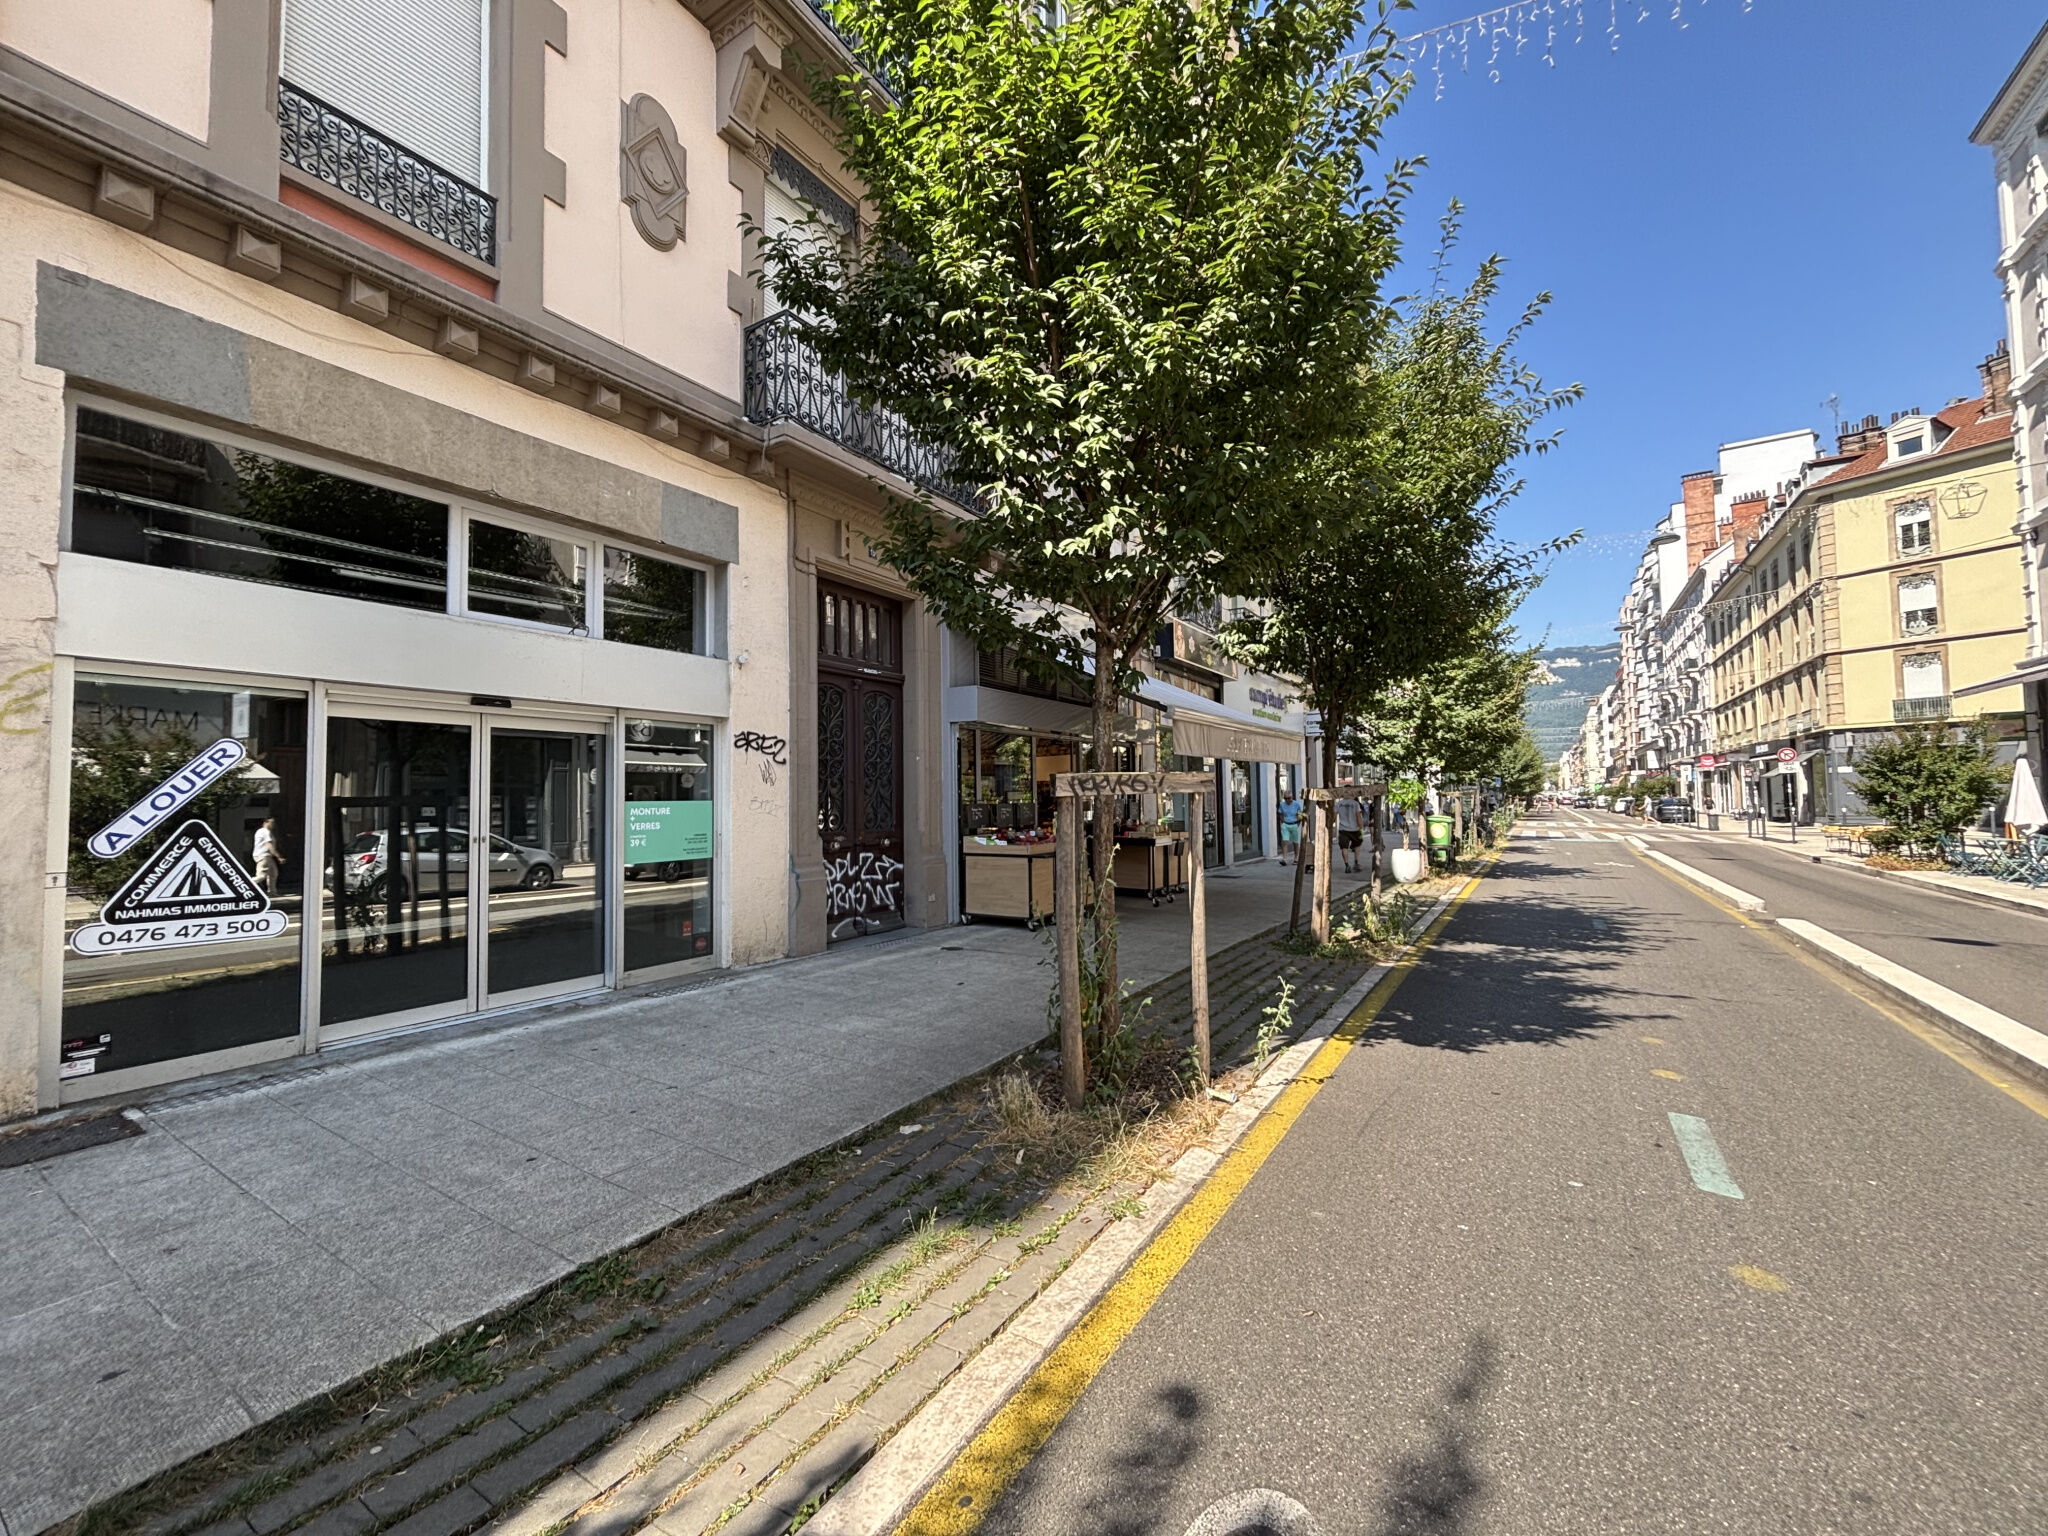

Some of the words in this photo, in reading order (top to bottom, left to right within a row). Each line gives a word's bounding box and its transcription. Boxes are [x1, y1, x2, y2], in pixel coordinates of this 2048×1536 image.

[104, 832, 133, 852] A
[129, 747, 236, 827] LOUER
[630, 807, 671, 816] MONTURE
[630, 822, 661, 831] VERRES
[630, 839, 641, 847] 39
[124, 836, 193, 908] COMMERCE
[198, 836, 255, 900] ENTREPRISE
[115, 906, 181, 920] NAHMIAS
[184, 900, 260, 914] IMMOBILIER
[98, 927, 165, 946] 0476
[174, 923, 219, 938] 473
[227, 919, 270, 934] 500
